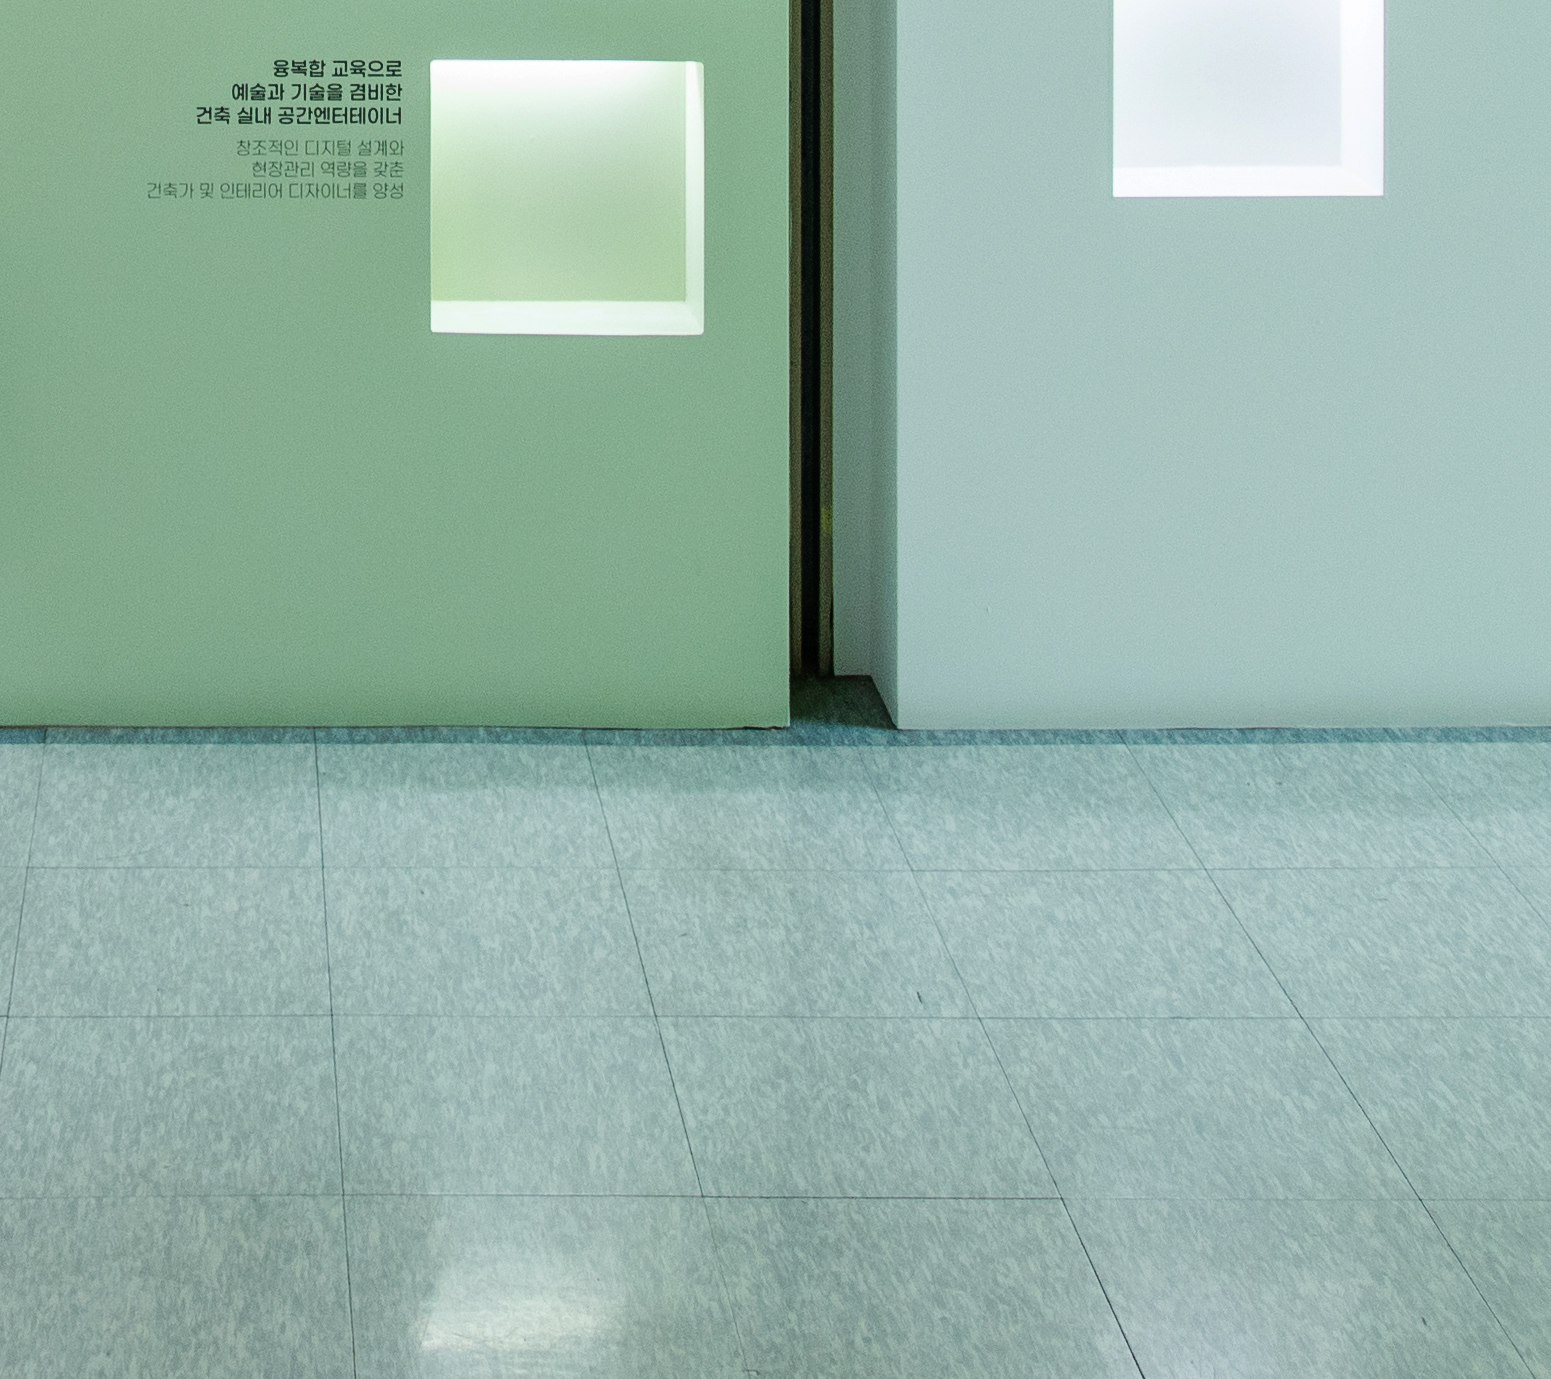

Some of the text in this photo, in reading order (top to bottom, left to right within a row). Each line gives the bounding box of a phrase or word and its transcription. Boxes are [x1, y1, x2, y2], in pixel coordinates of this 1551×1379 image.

[273, 59, 402, 78] 융복합 교육으로
[232, 83, 402, 101] 예술과 기술을 겸비한
[197, 106, 402, 125] 건축 실내 공간엔터테이너
[236, 140, 404, 157] 창조적인 디지털 설계와
[252, 161, 404, 179] 현장관리 역량을 갖춘
[147, 182, 404, 199] 건축가 및 인테리어 디자이너를 양성
